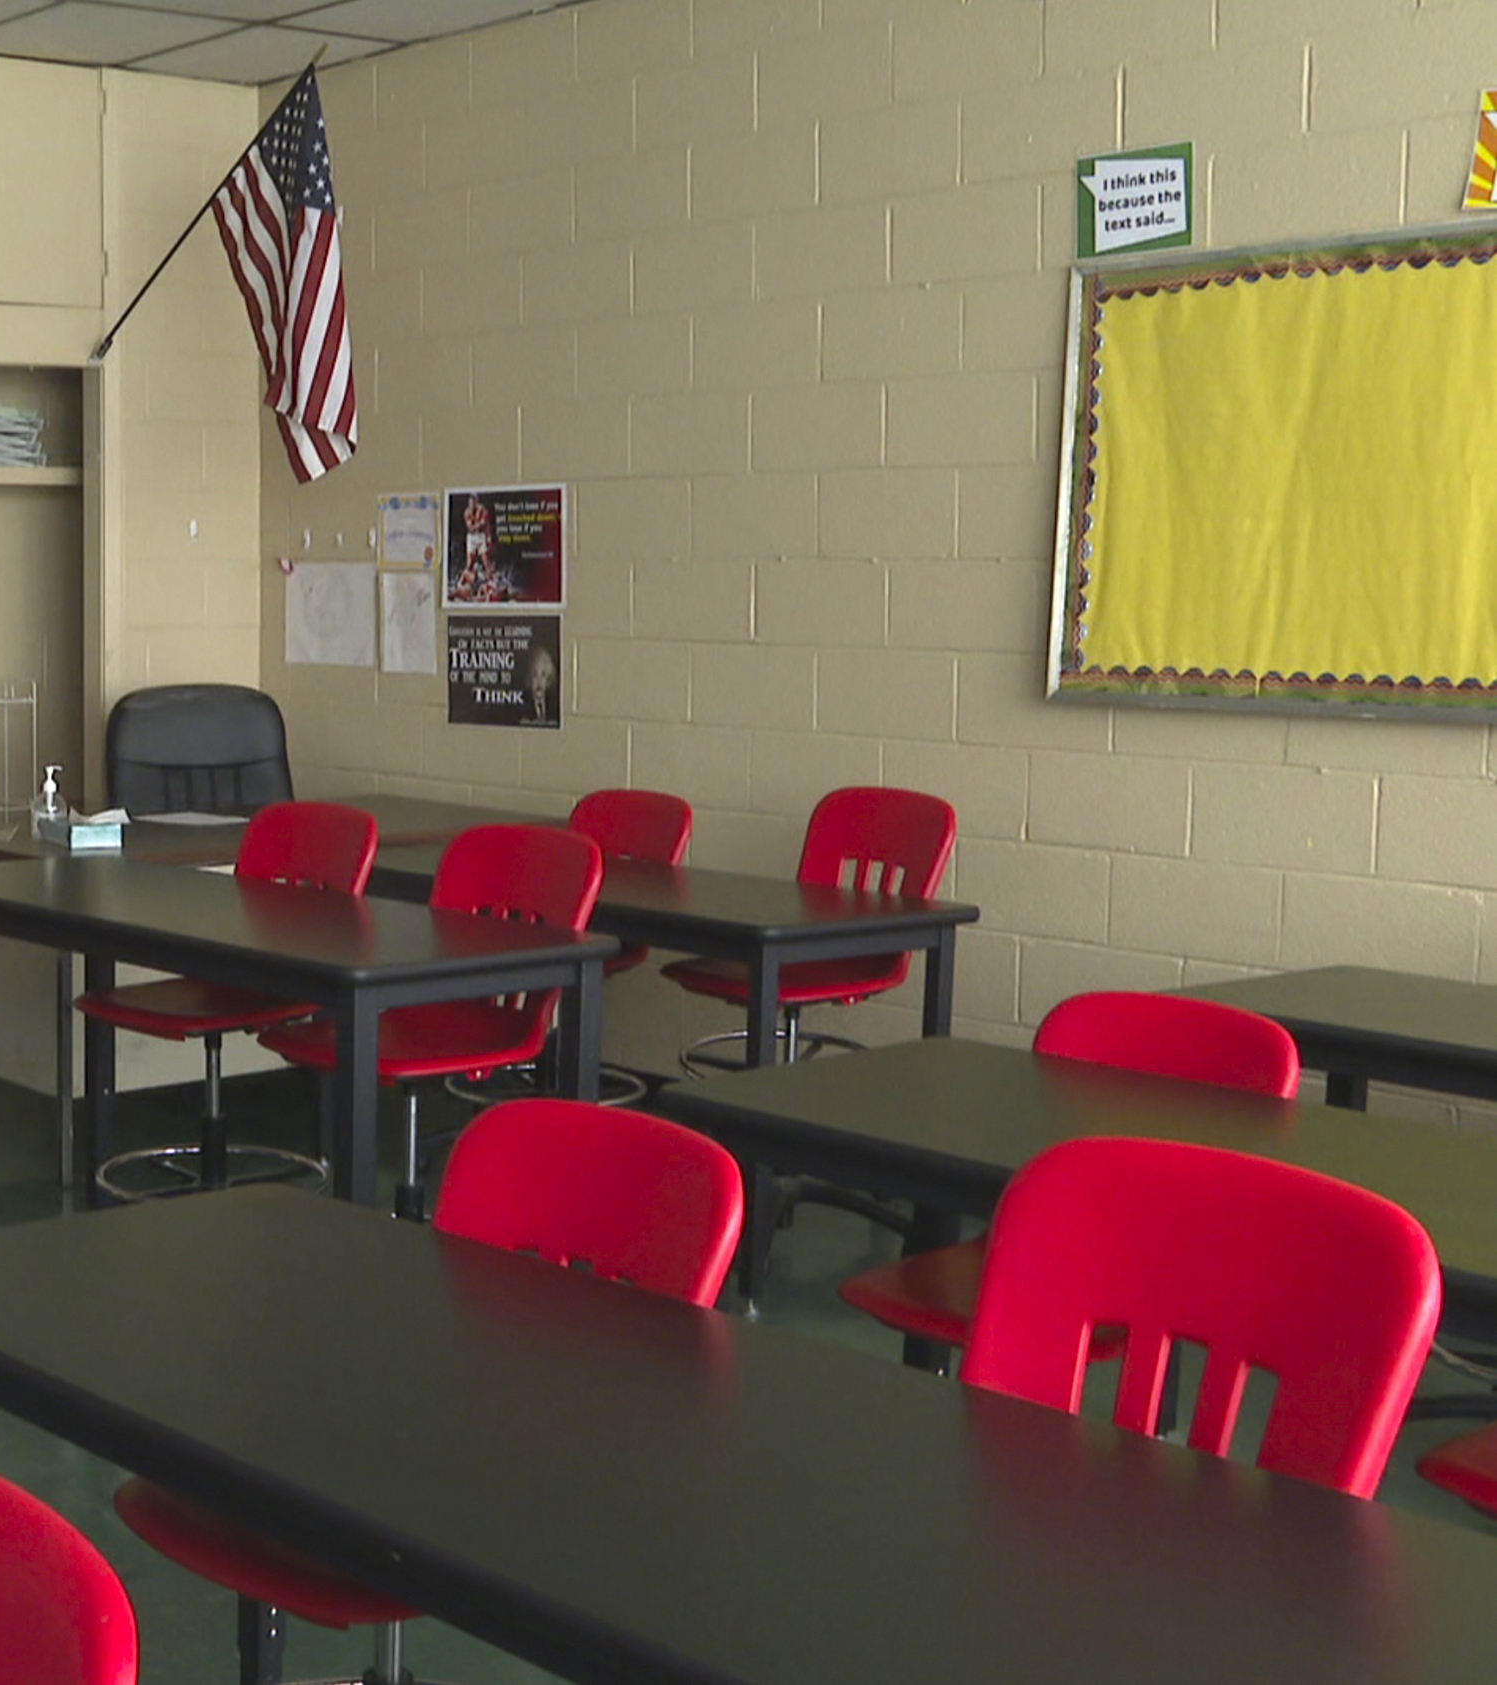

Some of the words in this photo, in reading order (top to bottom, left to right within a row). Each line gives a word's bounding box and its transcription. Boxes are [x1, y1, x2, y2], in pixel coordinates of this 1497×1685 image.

[1103, 179, 1108, 191] I
[1111, 173, 1146, 190] think
[1150, 168, 1177, 185] this
[1098, 194, 1155, 212] because
[1157, 189, 1182, 204] the
[1104, 217, 1132, 232] text
[449, 648, 514, 669] TRAINING
[474, 687, 524, 704] THINK
